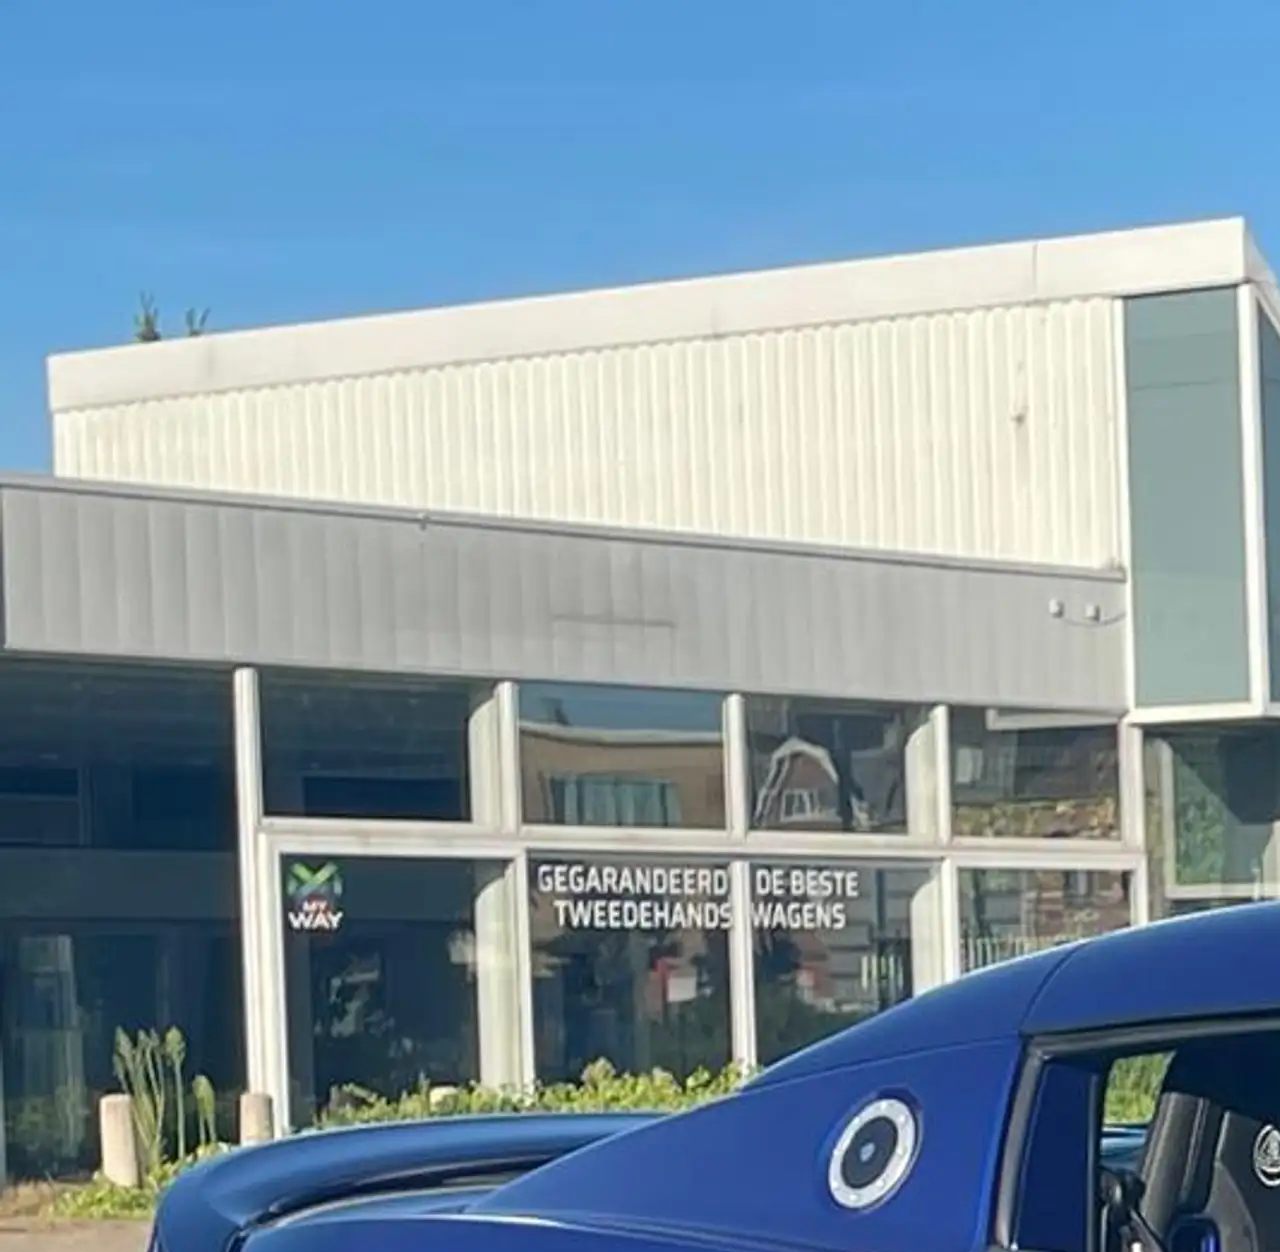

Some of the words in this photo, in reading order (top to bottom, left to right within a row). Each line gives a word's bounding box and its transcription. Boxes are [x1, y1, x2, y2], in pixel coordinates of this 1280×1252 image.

[538, 864, 728, 896] GEGARANDEERD
[756, 868, 784, 896] DE
[790, 869, 859, 897] BESTE
[288, 911, 343, 929] WAY
